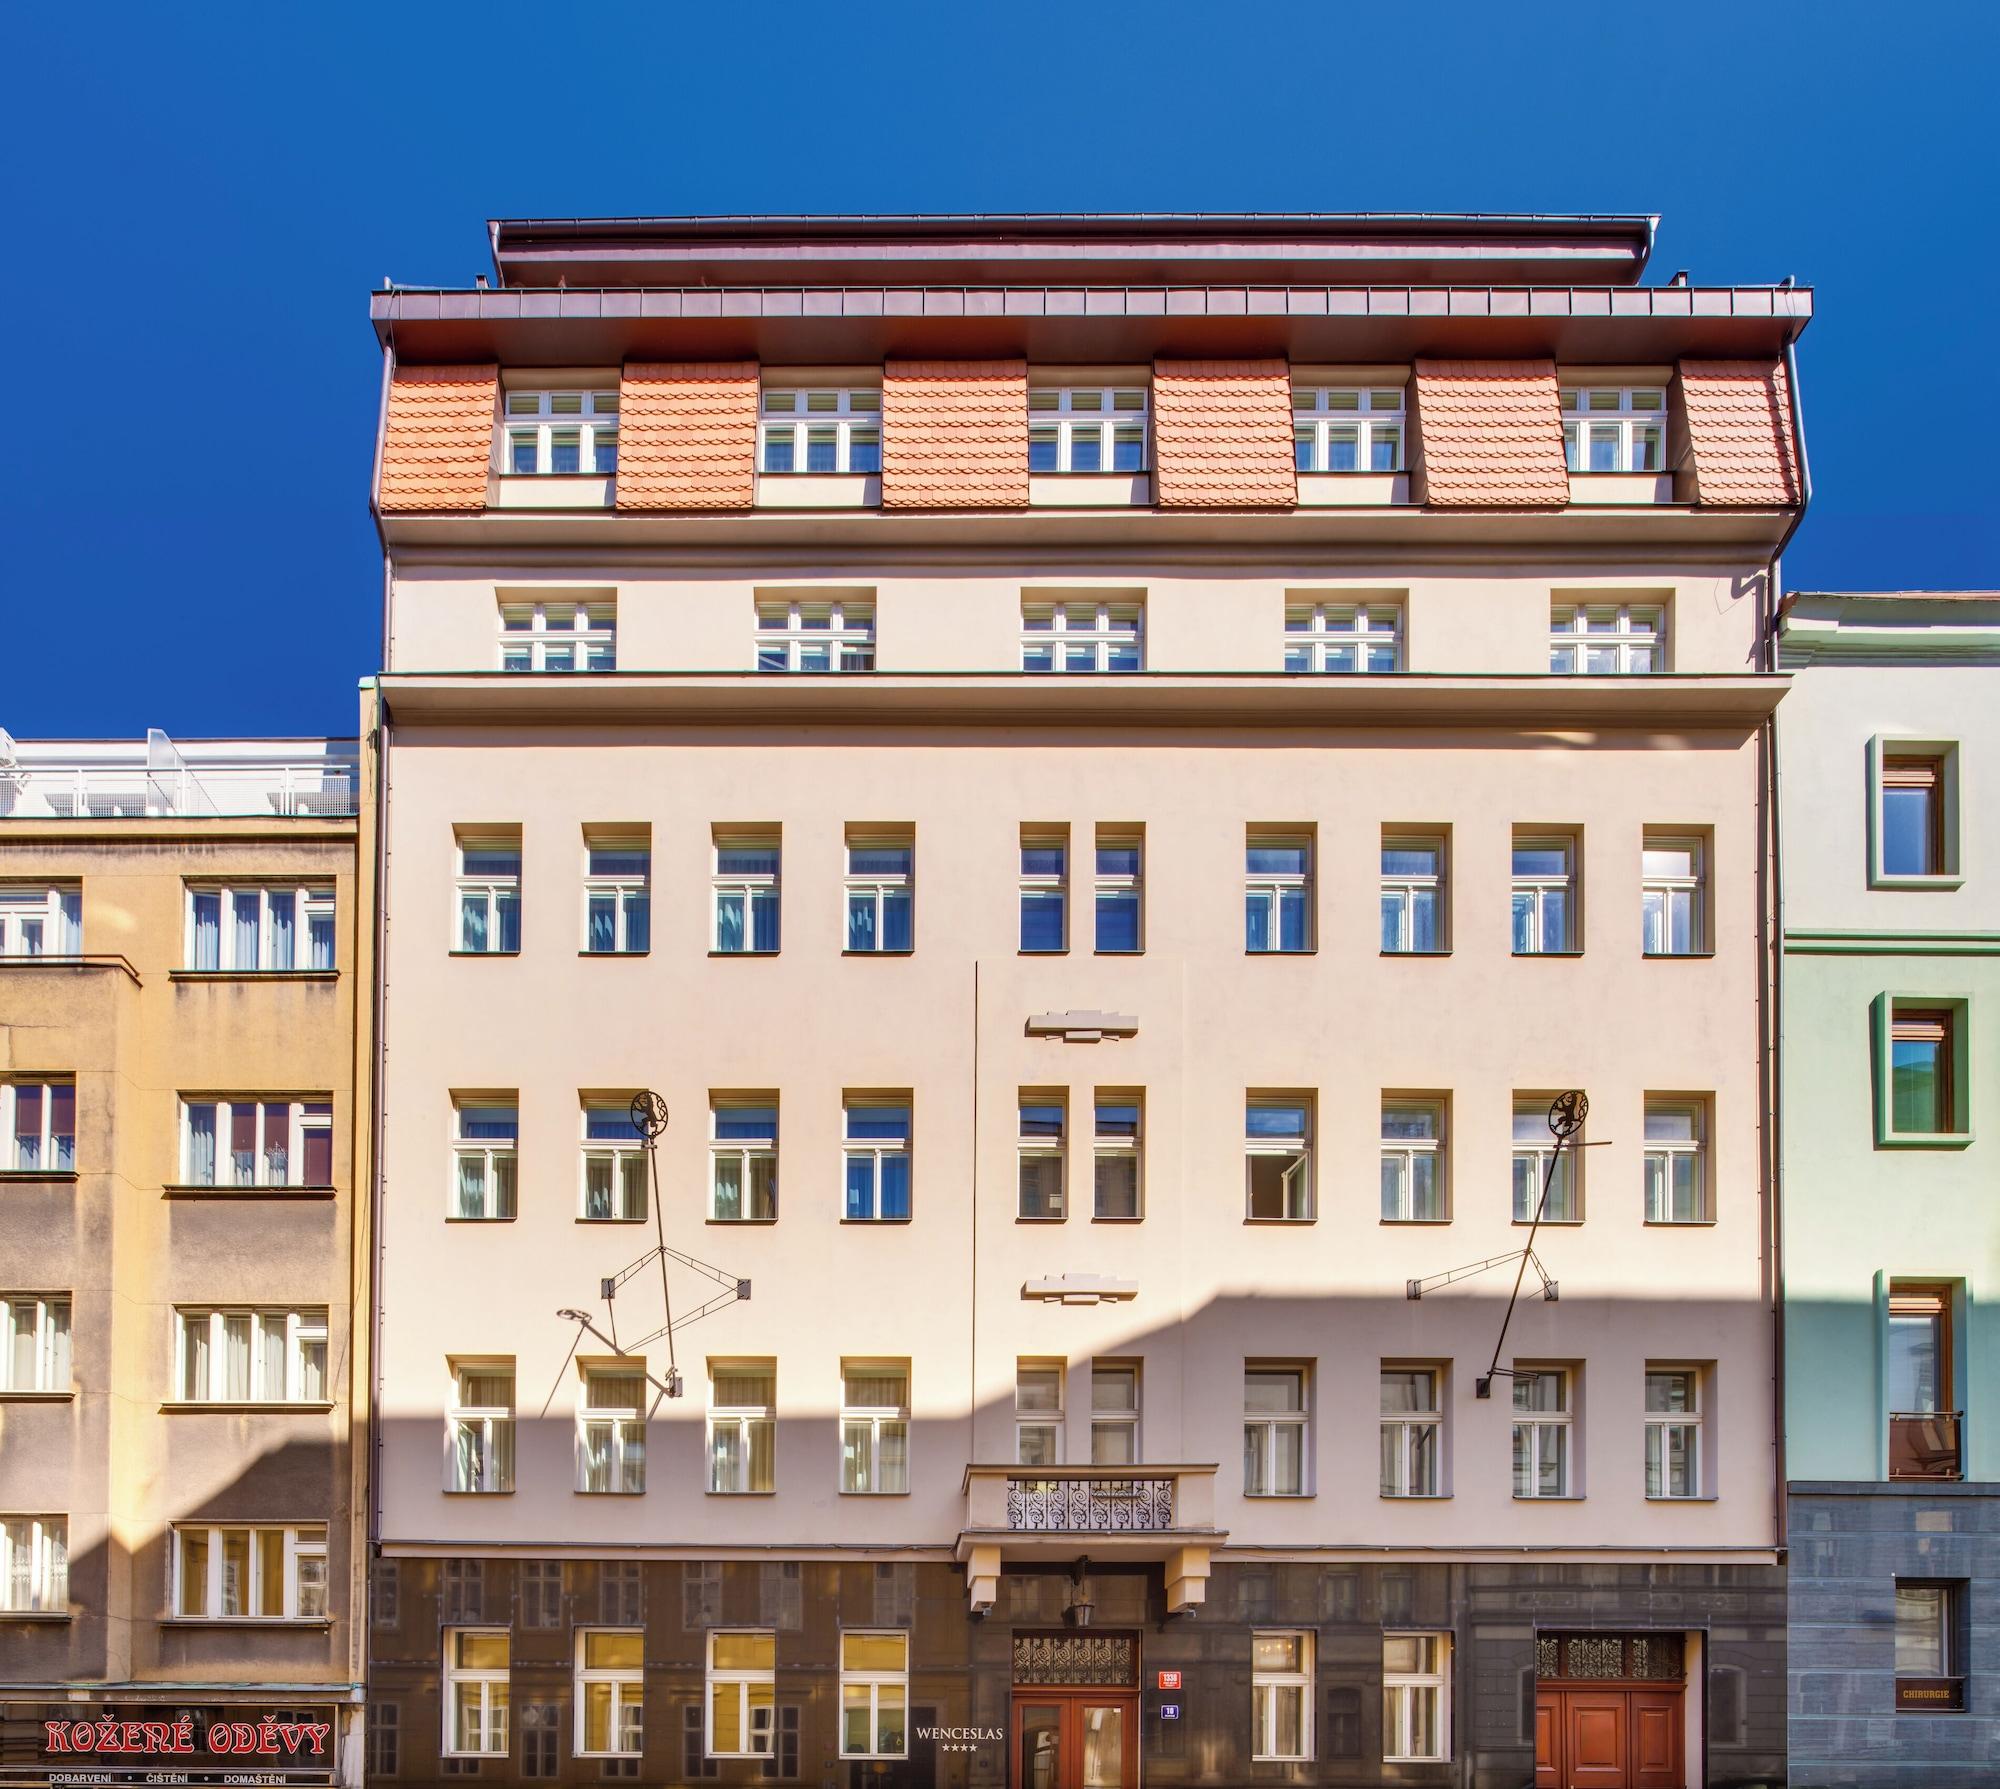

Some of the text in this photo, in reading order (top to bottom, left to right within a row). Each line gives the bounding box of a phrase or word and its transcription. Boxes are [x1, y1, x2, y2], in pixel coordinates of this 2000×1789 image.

[1903, 1689, 1950, 1699] CHIRURGIE
[45, 1714, 330, 1754] KOŽENÉ ODĚVY
[916, 1727, 1003, 1740] WENCESLAS
[49, 1773, 286, 1784] DOBARVENÍ ČIŠTĚNÍ DOMAŠTĚNÍ
